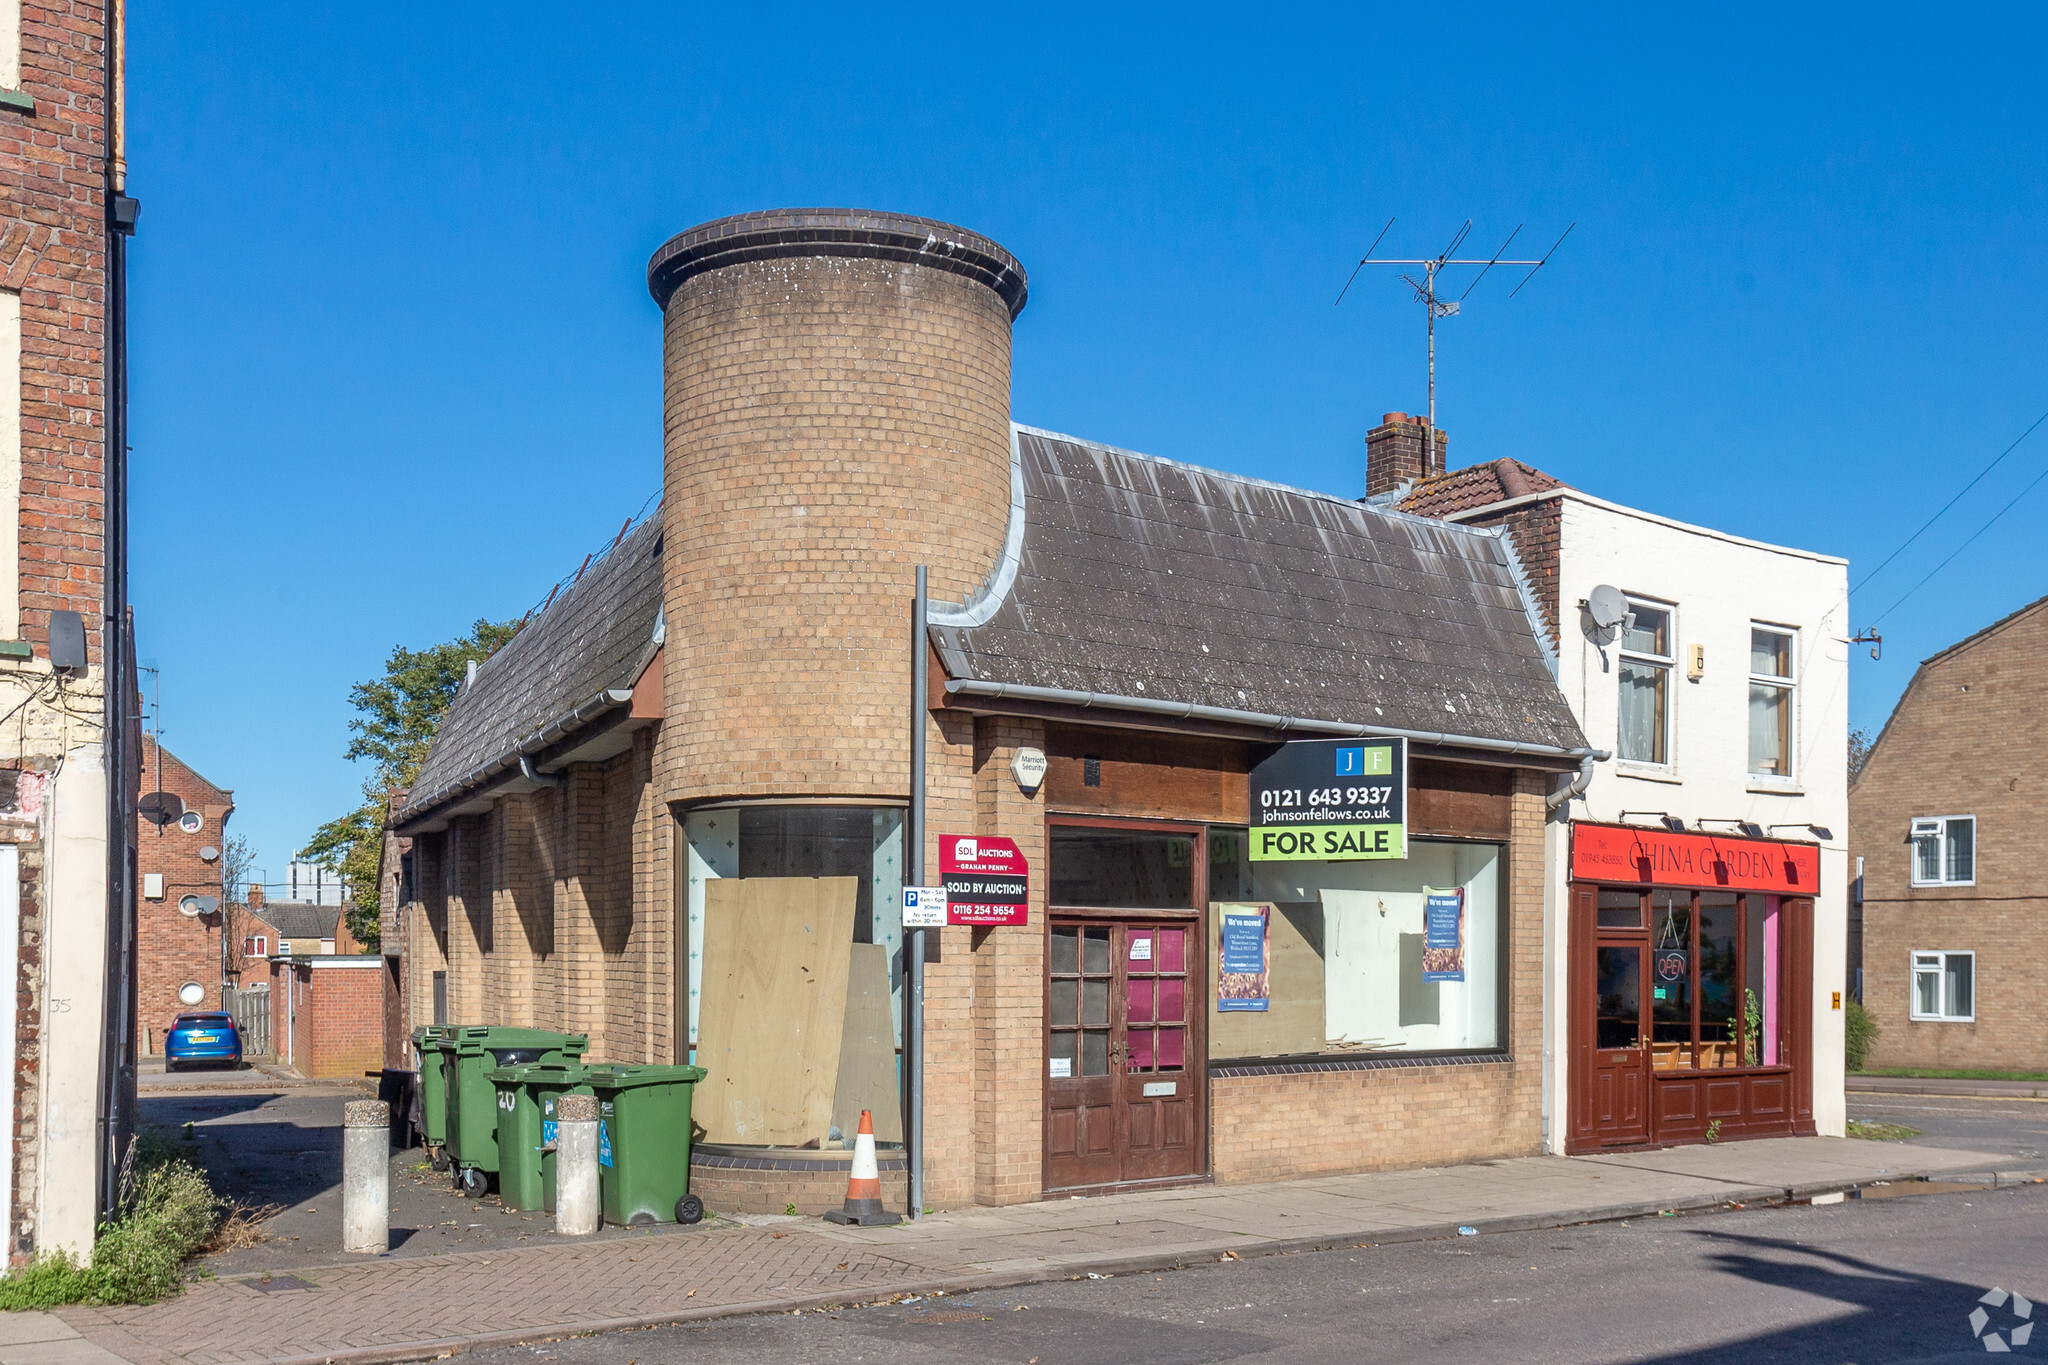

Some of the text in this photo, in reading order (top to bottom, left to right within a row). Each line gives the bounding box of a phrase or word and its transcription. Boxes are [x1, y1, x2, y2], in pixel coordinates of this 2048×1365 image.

[1022, 763, 1045, 773] Security
[1345, 751, 1382, 772] J F
[1260, 786, 1392, 808] 0121 643 9337
[1262, 805, 1391, 825] johnsonfellows.co.uk
[1262, 831, 1317, 855] FOR
[1324, 830, 1389, 854] SALE
[958, 846, 1013, 858] SDL AUCTIONS
[1629, 841, 1774, 878] CHINA GARDEN
[947, 881, 1022, 895] SOLD BY AUCTION
[907, 892, 917, 906] P
[1429, 898, 1441, 906] We've
[953, 904, 1015, 916] 0116 254 9654
[1228, 918, 1262, 927] We've moved
[1658, 958, 1686, 975] OPEN
[49, 998, 72, 1013] 35
[497, 1091, 516, 1112] 20
